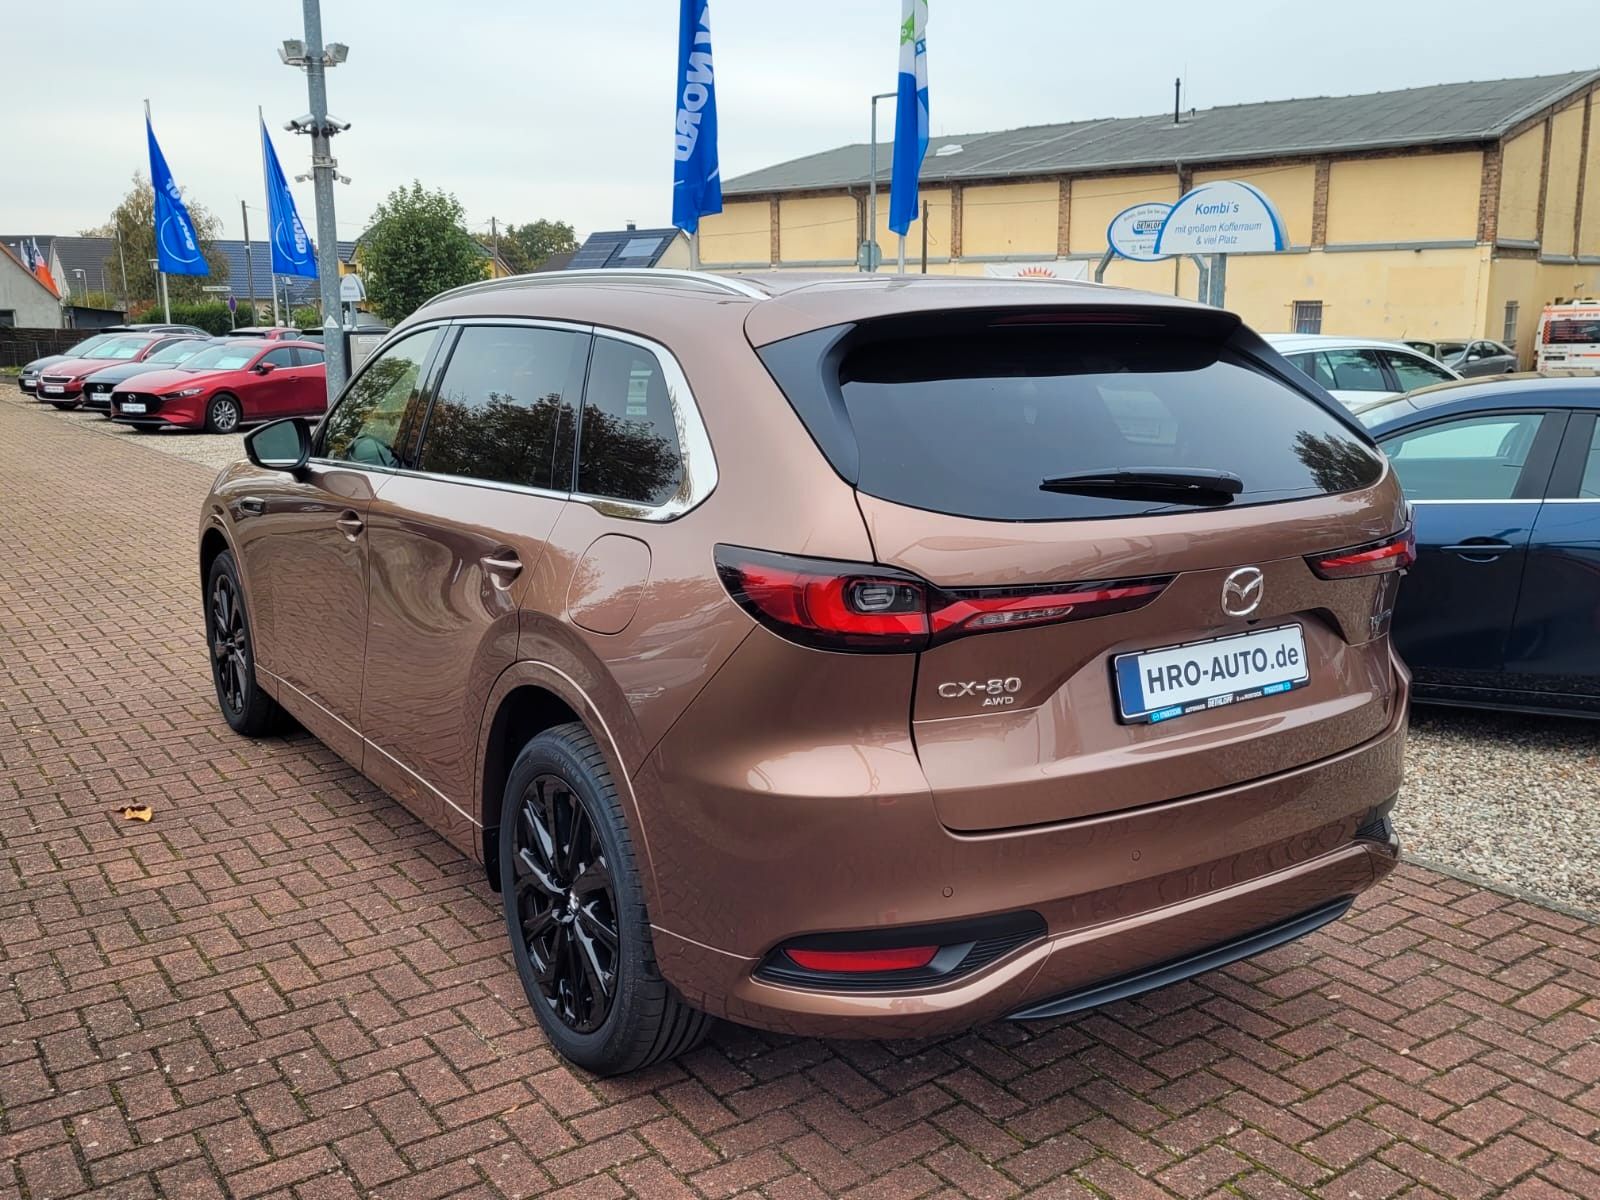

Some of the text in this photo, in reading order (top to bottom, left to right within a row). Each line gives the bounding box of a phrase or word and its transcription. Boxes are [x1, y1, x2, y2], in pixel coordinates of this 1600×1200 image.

[1175, 222, 1261, 235] mit großem Kofferraum
[1204, 236, 1216, 244] viel
[1219, 235, 1237, 244] Platz
[1147, 644, 1298, 693] HRO-AUTO.de
[938, 677, 1022, 697] CX-80
[982, 696, 1014, 706] AWD
